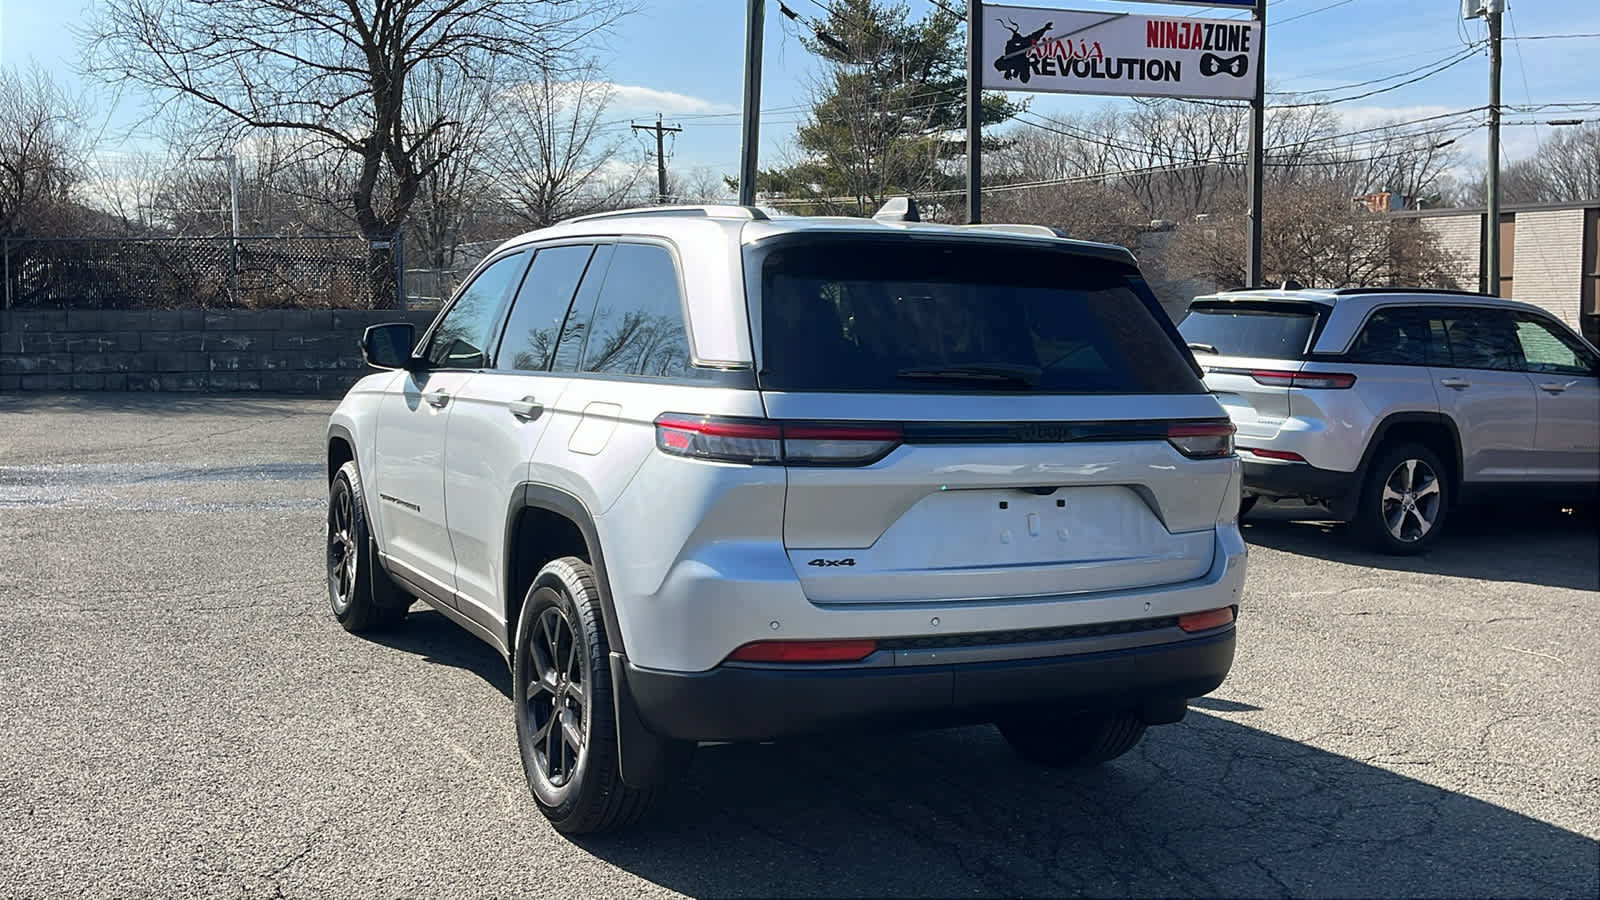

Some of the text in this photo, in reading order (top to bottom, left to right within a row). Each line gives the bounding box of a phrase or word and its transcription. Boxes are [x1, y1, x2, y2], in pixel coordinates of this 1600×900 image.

[1147, 20, 1252, 53] NINJAZONE
[1027, 54, 1181, 82] REVOLUTION
[808, 558, 856, 567] 4x4
